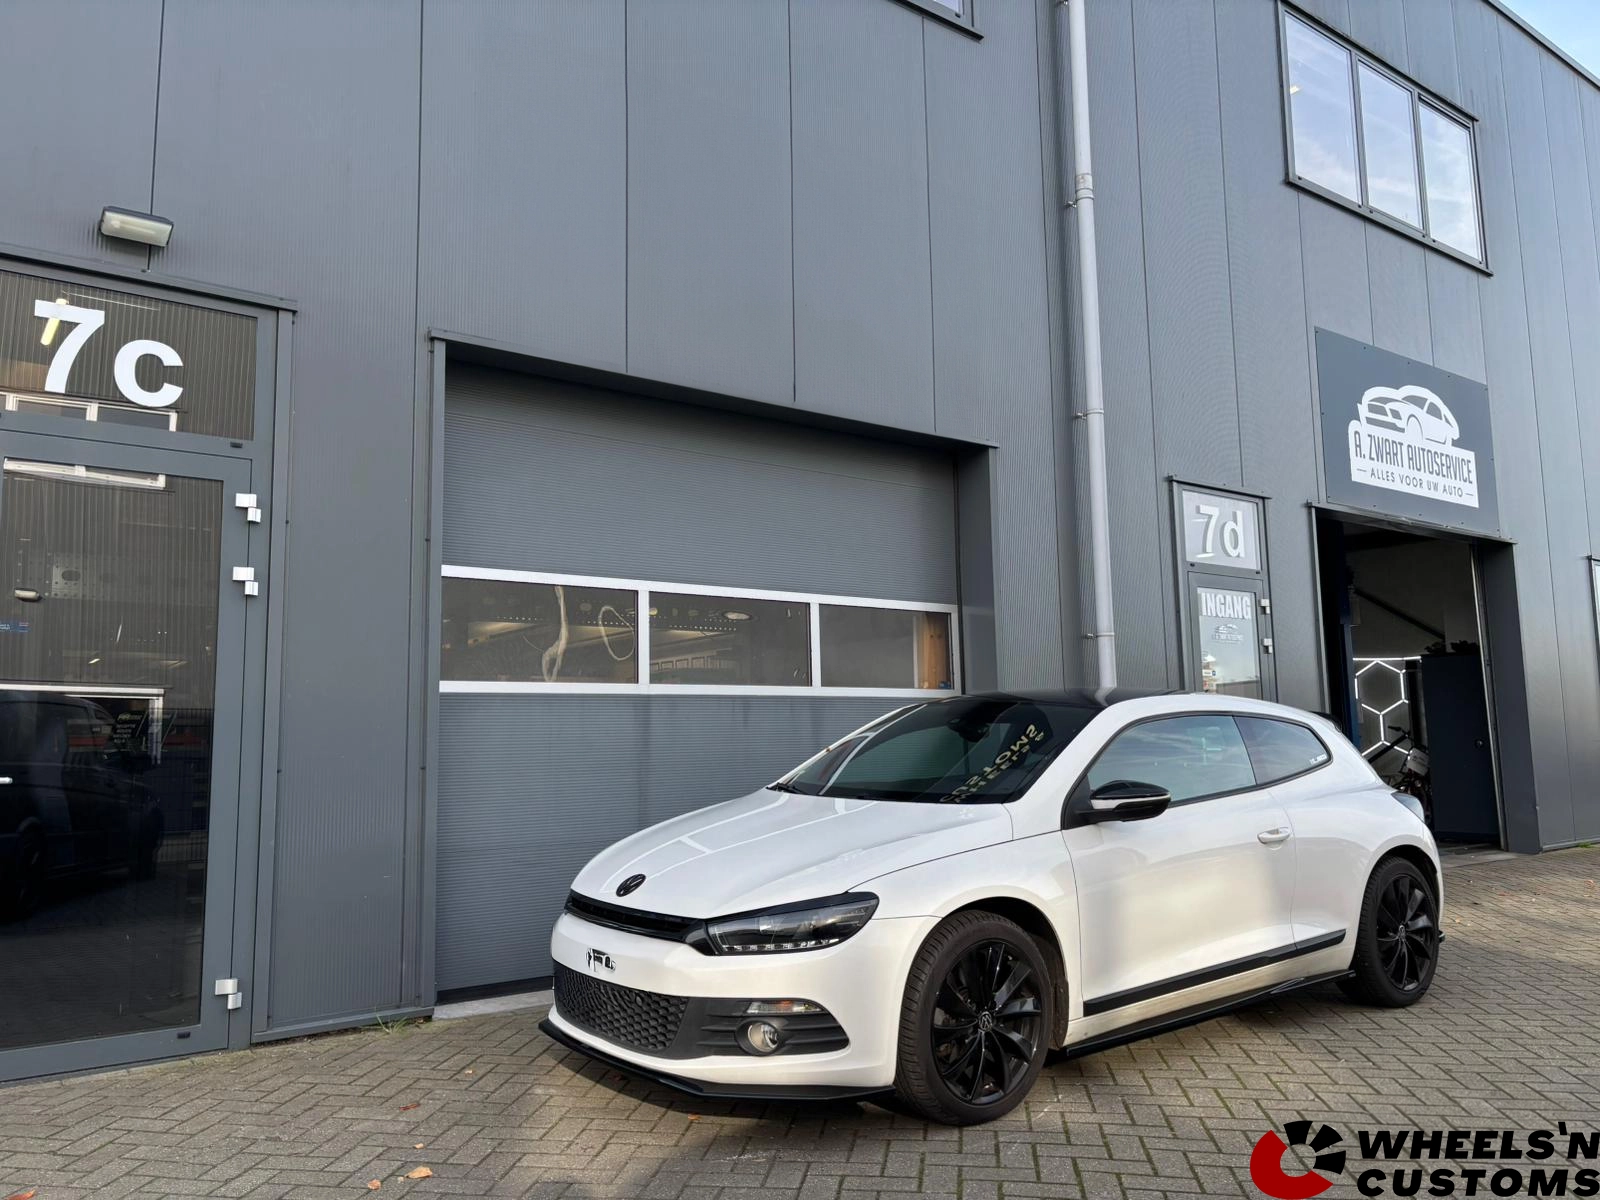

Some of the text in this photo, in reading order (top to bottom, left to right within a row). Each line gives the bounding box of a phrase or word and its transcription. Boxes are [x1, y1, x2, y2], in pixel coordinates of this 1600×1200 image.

[1367, 433, 1404, 468] ZWART
[1406, 443, 1473, 485] AUTOSERVICE
[1370, 467, 1464, 498] ALLES VOOR UW AUTO
[1198, 504, 1245, 558] 7d
[1201, 592, 1251, 619] INGANG
